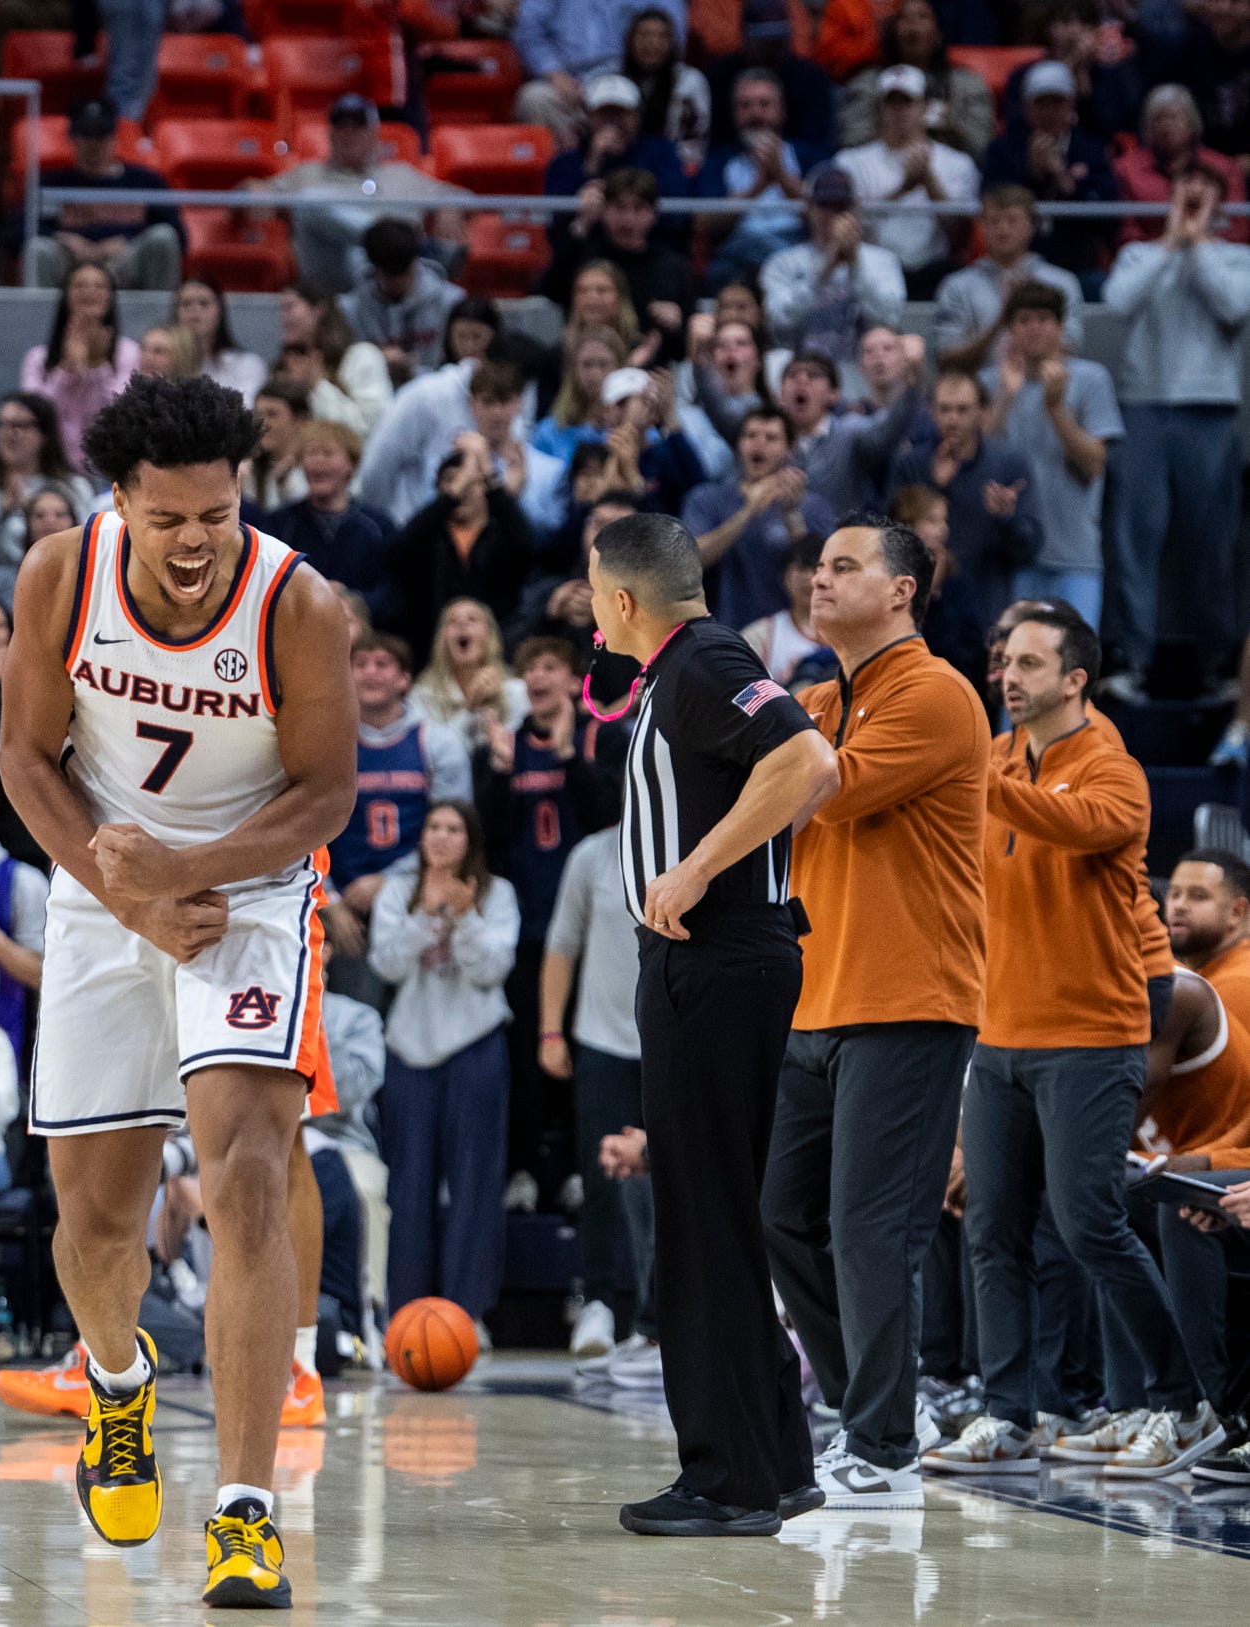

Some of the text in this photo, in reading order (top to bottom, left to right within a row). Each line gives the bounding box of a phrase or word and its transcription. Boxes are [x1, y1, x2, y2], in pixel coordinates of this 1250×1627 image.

[73, 658, 262, 718] AUBURN
[216, 650, 247, 681] SEC
[135, 720, 195, 795] 7
[367, 800, 399, 849] 0
[535, 801, 560, 850] 0
